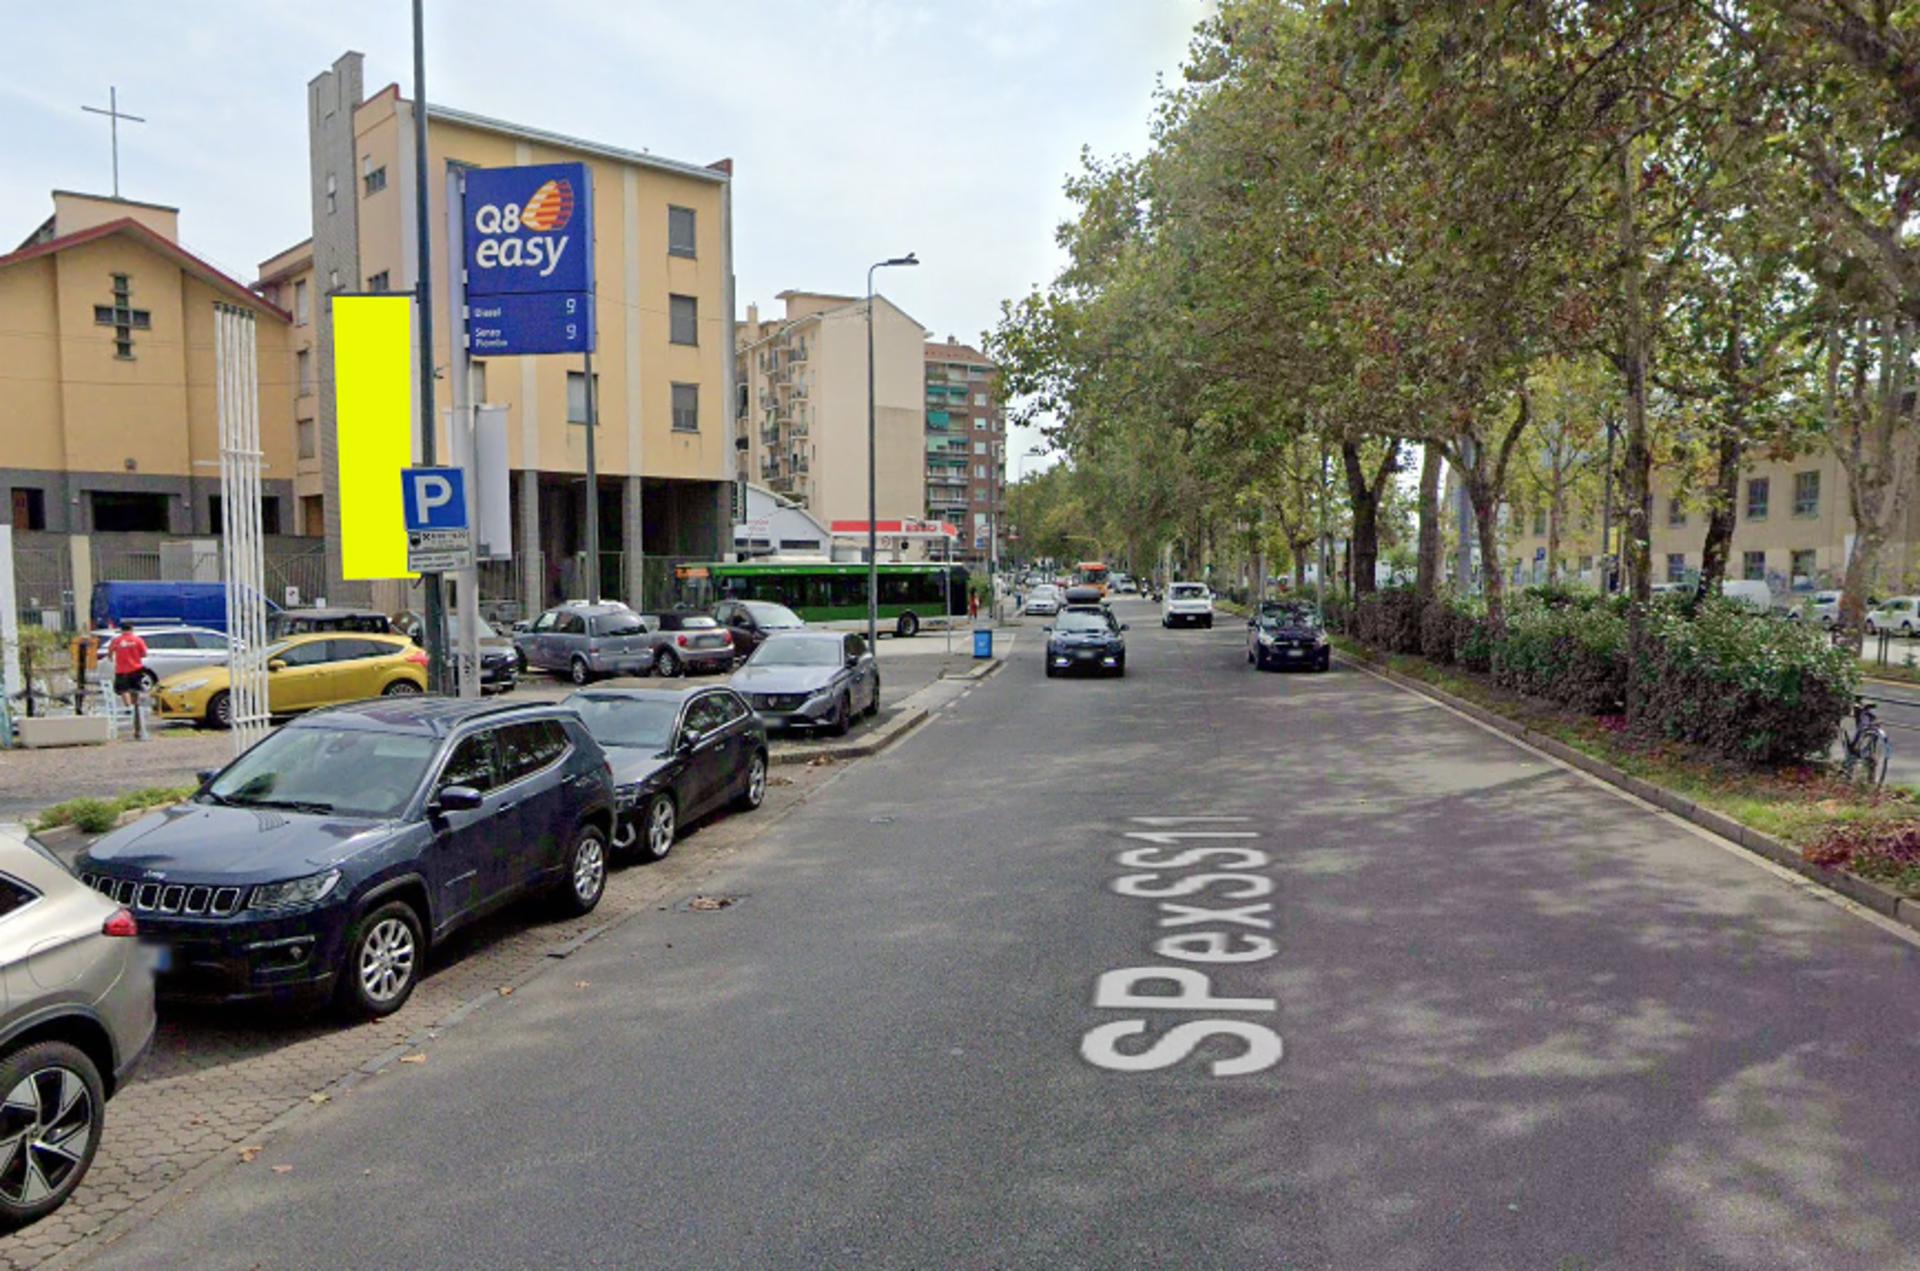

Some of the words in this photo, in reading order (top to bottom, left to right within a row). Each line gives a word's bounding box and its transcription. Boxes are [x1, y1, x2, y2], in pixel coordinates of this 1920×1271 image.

[475, 203, 520, 235] Q8
[476, 235, 569, 277] easy
[566, 298, 577, 315] 9
[566, 323, 578, 340] 9
[414, 475, 452, 524] P
